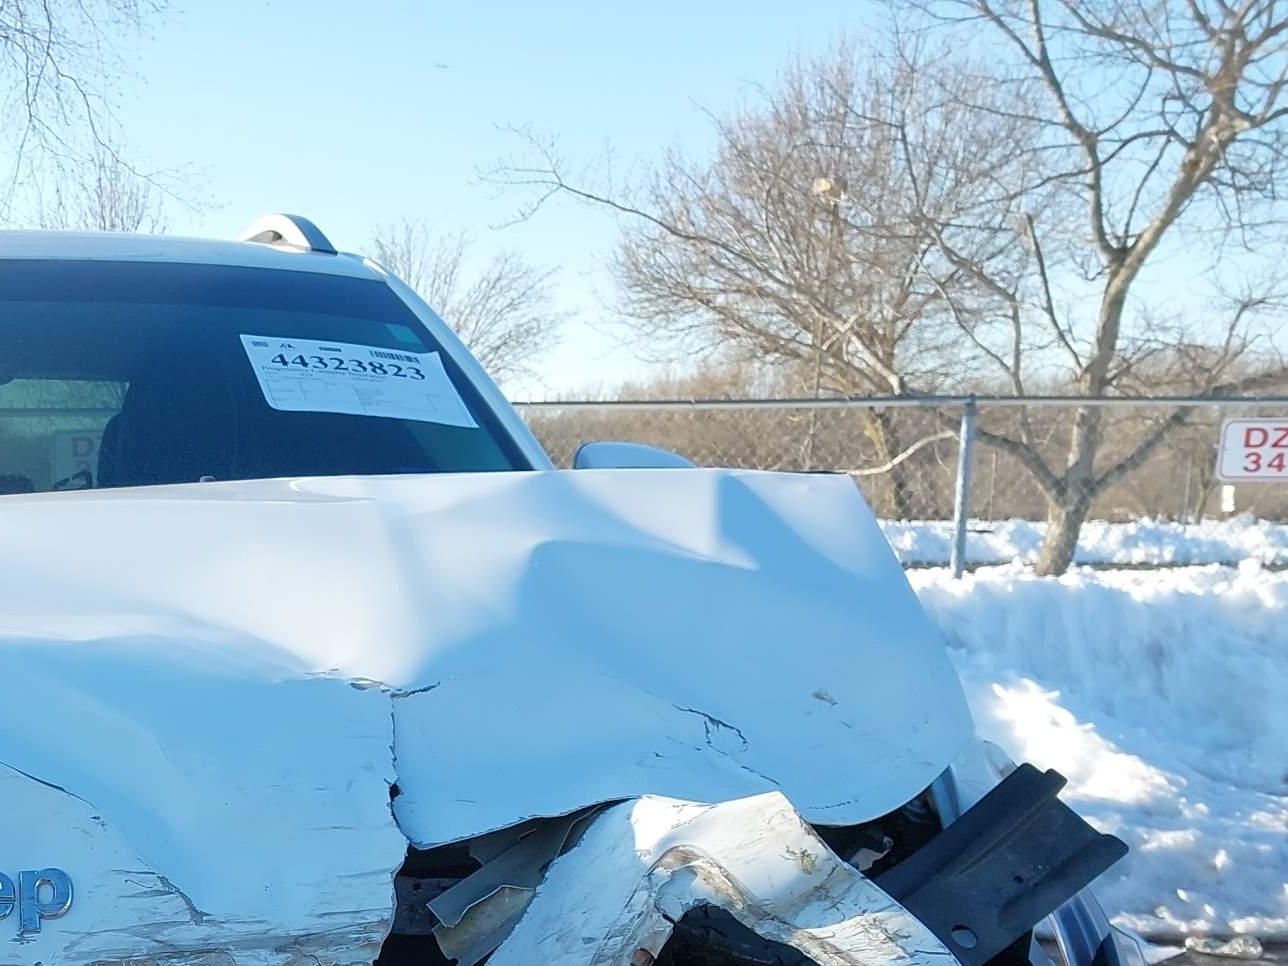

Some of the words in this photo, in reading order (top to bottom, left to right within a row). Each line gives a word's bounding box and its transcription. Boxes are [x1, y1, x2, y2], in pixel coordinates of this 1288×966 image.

[271, 353, 426, 381] 44323823
[1243, 427, 1288, 448] DZ
[1243, 452, 1286, 472] 34
